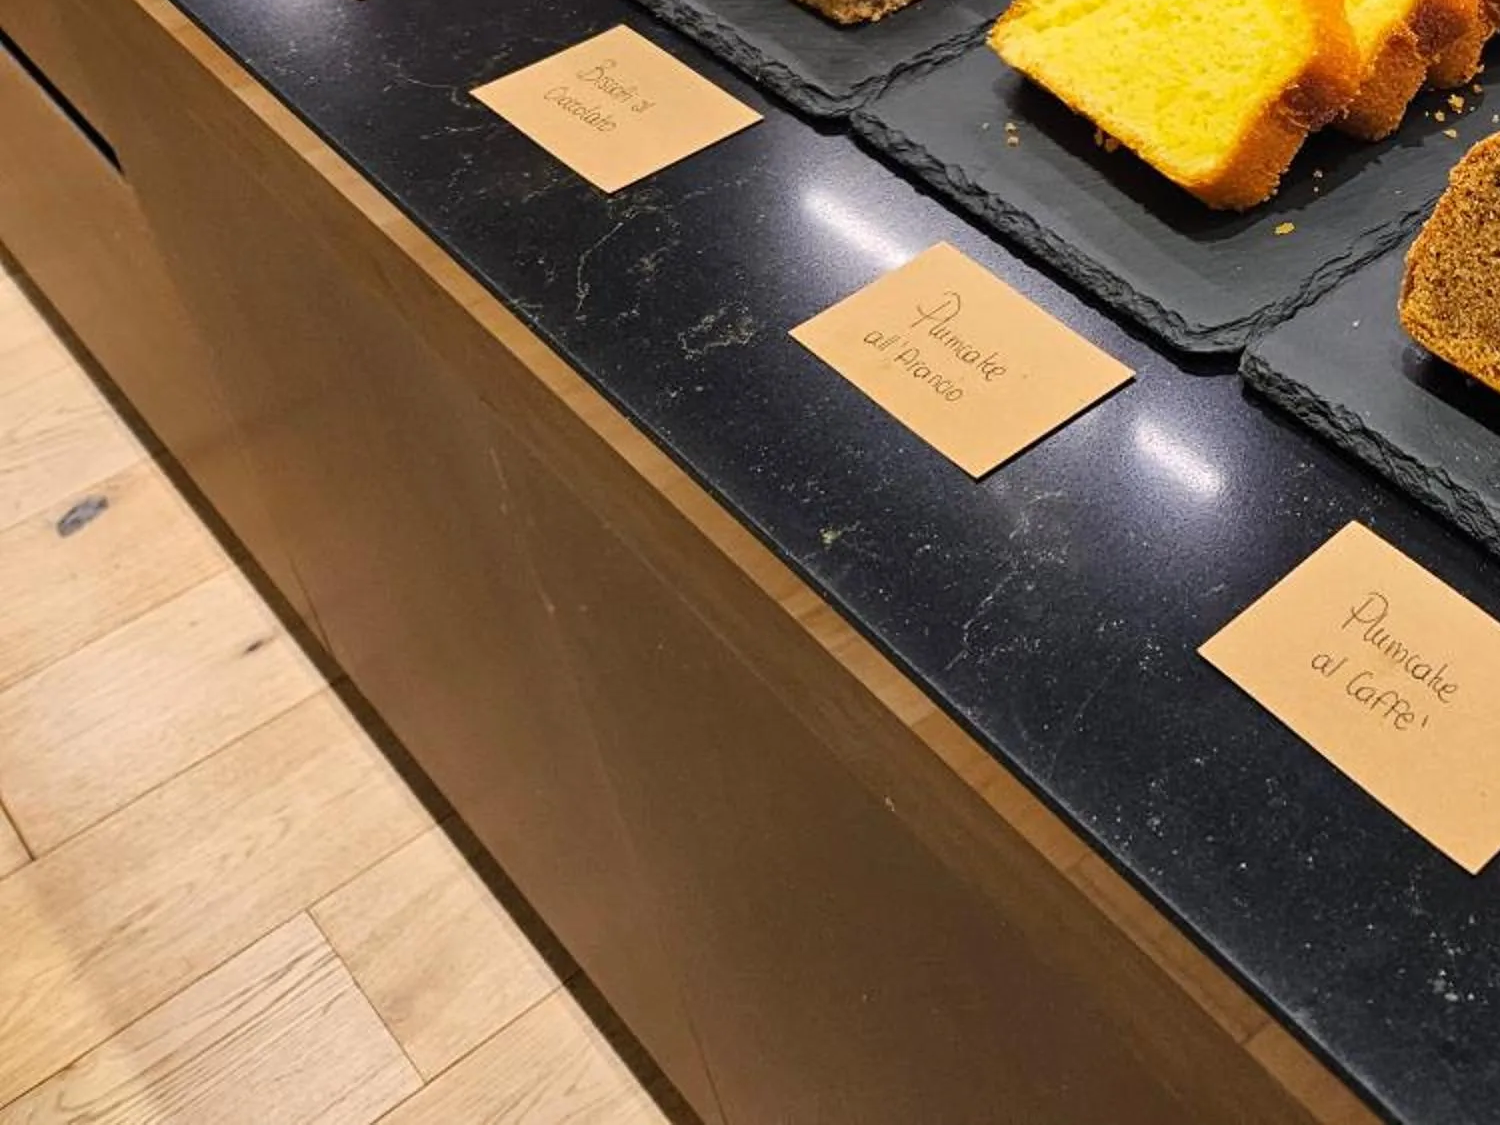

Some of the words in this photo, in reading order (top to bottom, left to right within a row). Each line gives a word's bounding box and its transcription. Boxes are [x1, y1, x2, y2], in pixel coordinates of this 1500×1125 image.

[911, 290, 1007, 382] Plumcake
[1311, 653, 1349, 677] al
[1341, 591, 1458, 704] Plumcake
